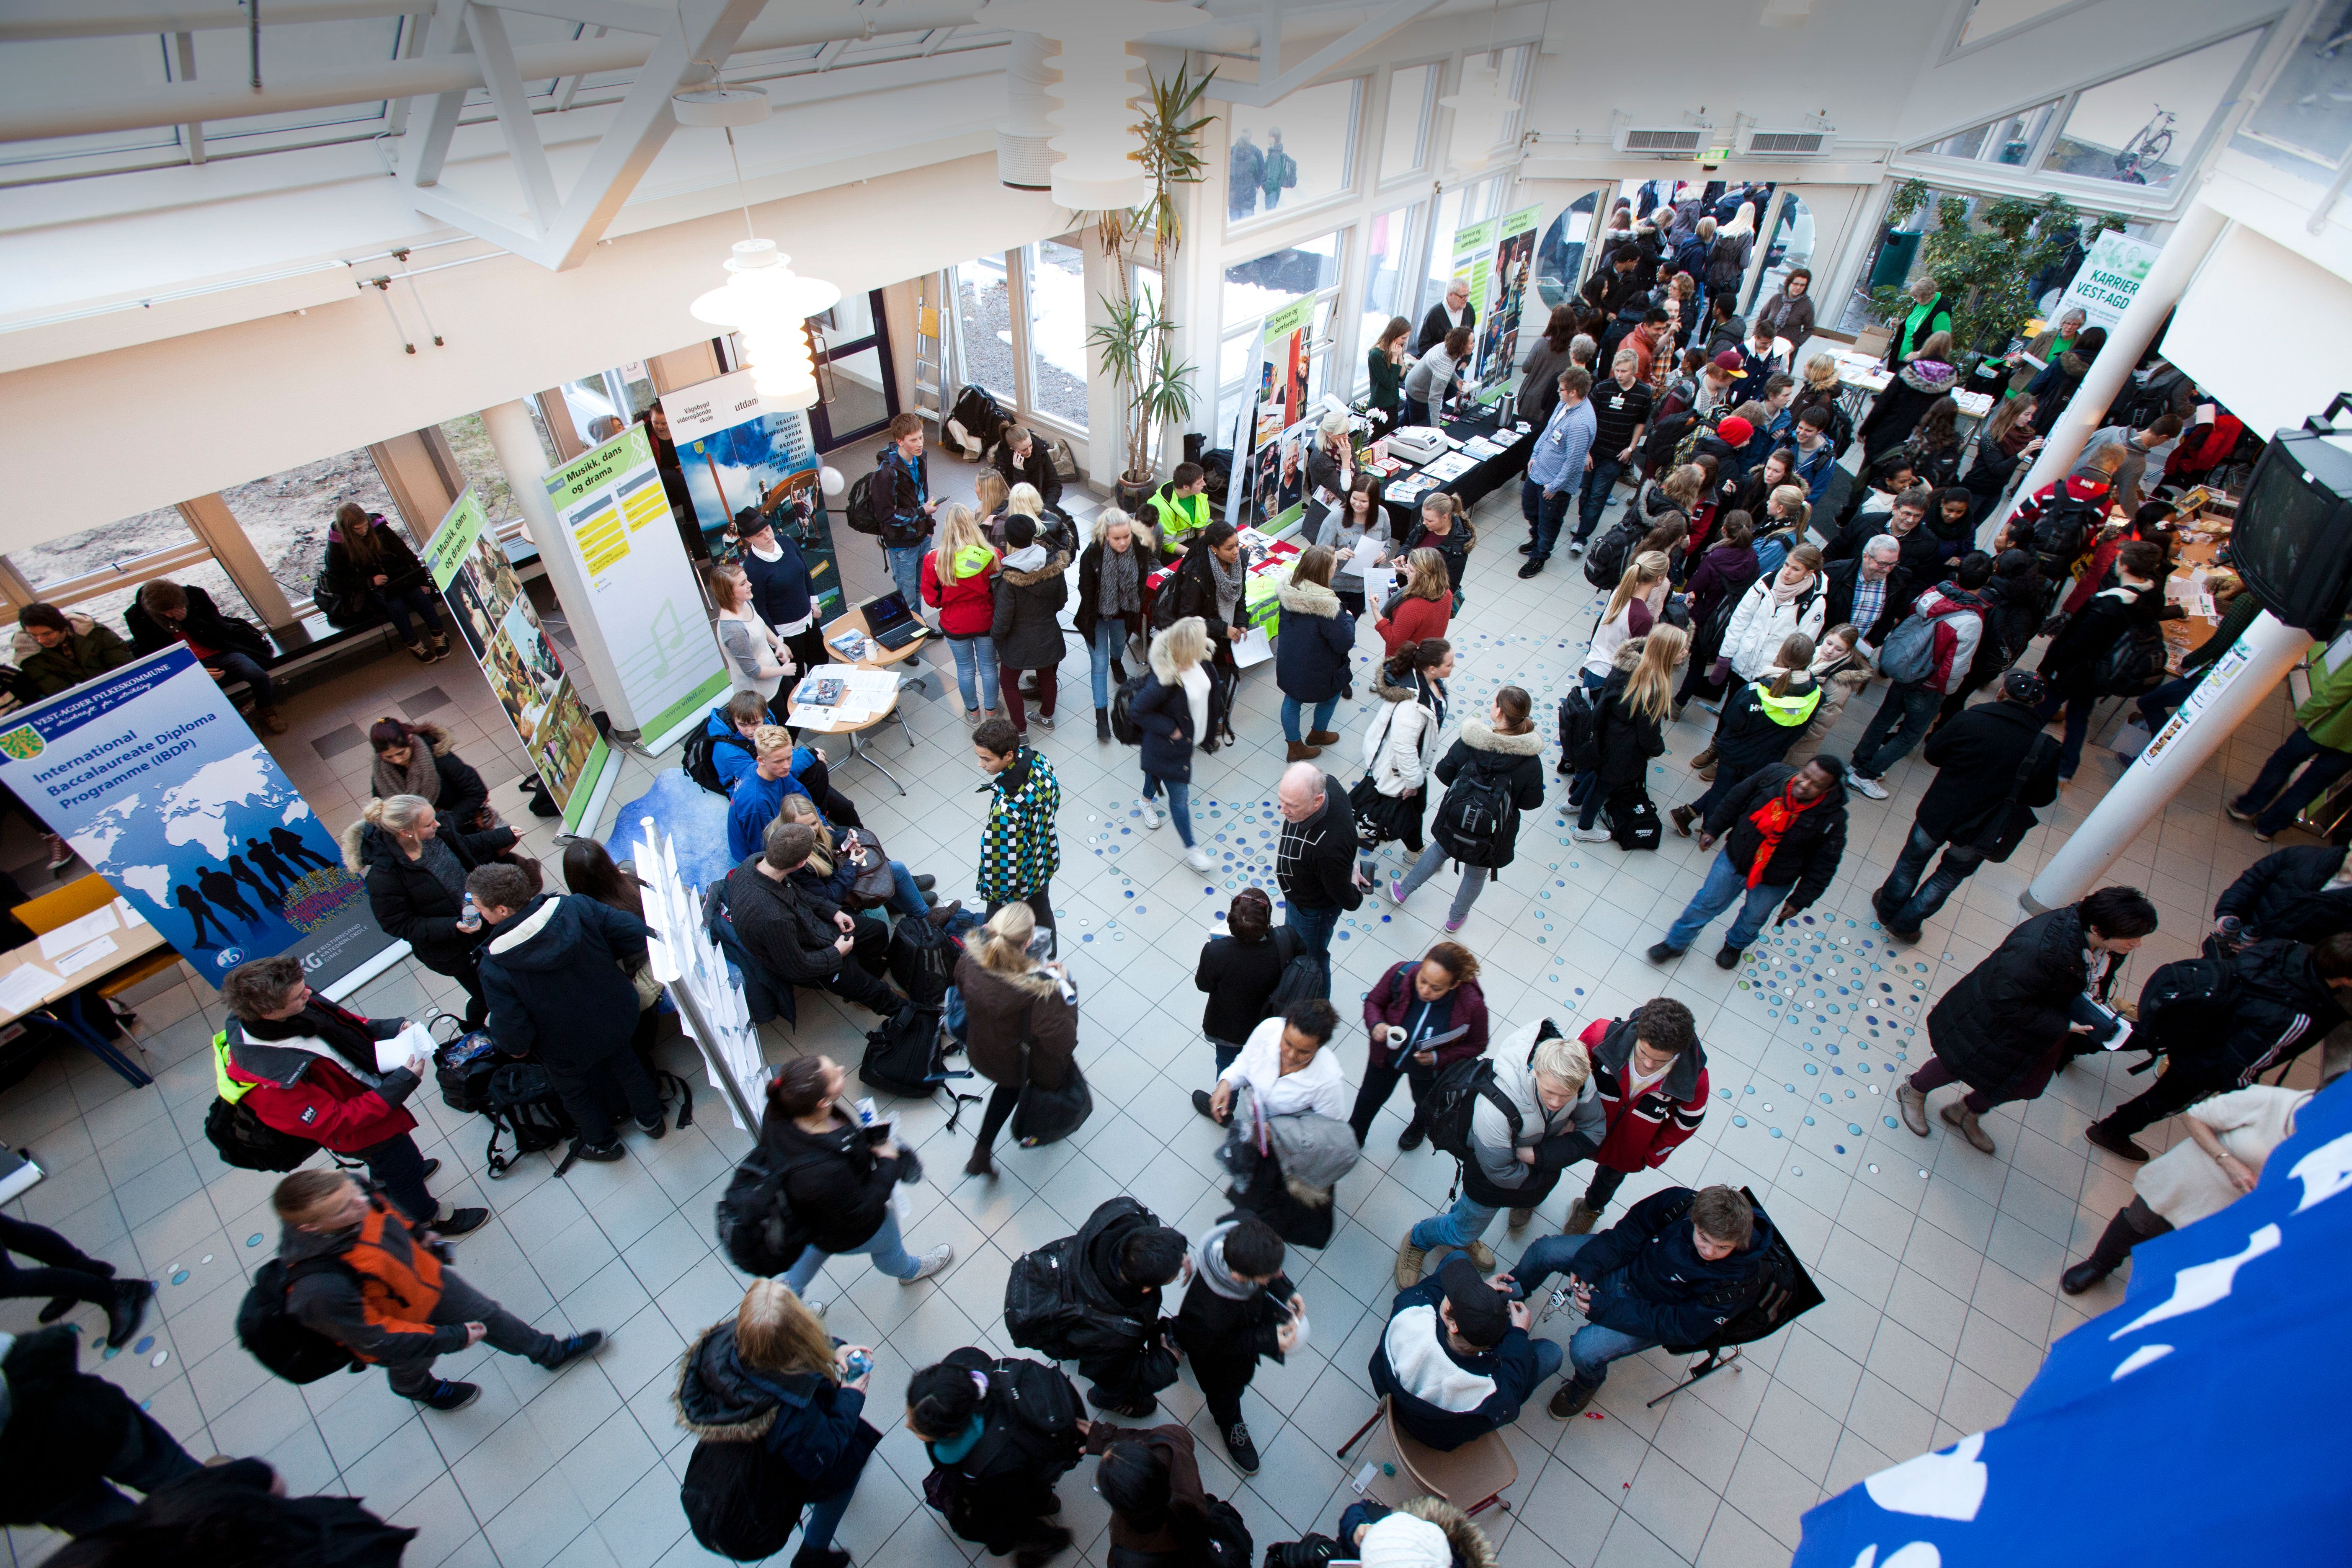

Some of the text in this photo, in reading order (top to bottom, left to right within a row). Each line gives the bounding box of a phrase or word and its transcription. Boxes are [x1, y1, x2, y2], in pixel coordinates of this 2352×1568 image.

[1509, 222, 1527, 232] samferdsel
[1510, 215, 1522, 224] Service
[1461, 237, 1481, 248] samferdsel
[2090, 269, 2140, 295] KARRIER
[2076, 281, 2130, 309] VEST-AGD
[1274, 316, 1298, 334] samferdsel
[1275, 311, 1291, 324] Service
[676, 408, 712, 424] videregående
[684, 401, 710, 414] Vågsbygd
[699, 415, 714, 424] skole
[776, 414, 799, 426] REALFAG
[762, 422, 801, 439] SAMFUNNSFAG
[784, 429, 802, 439] SPRÅK
[779, 437, 804, 449] ØKONOMI
[566, 459, 601, 482] Musikk,
[602, 446, 623, 462] dans
[746, 444, 805, 471] MUSIKK, DANS, DRAMA
[769, 451, 807, 469] BREDDEIDRETT
[776, 458, 808, 474] TOPPIDRETT
[572, 466, 613, 494] og drama
[437, 529, 457, 556] Musikk,
[455, 512, 467, 530] dans
[445, 535, 467, 569] og drama
[34, 663, 171, 727] VEST-AGDER FYLKESKOMMUNE
[665, 687, 706, 719] www.vilbli.no
[33, 730, 138, 783] International
[46, 713, 217, 797] Baccalaureate Diploma
[59, 738, 197, 810] Programme (IBDP)
[316, 923, 361, 954] KRISTIANSAND
[320, 925, 369, 958] KATEDRALSKOLE
[324, 948, 343, 963] GIMLE
[301, 1106, 314, 1121] HH
